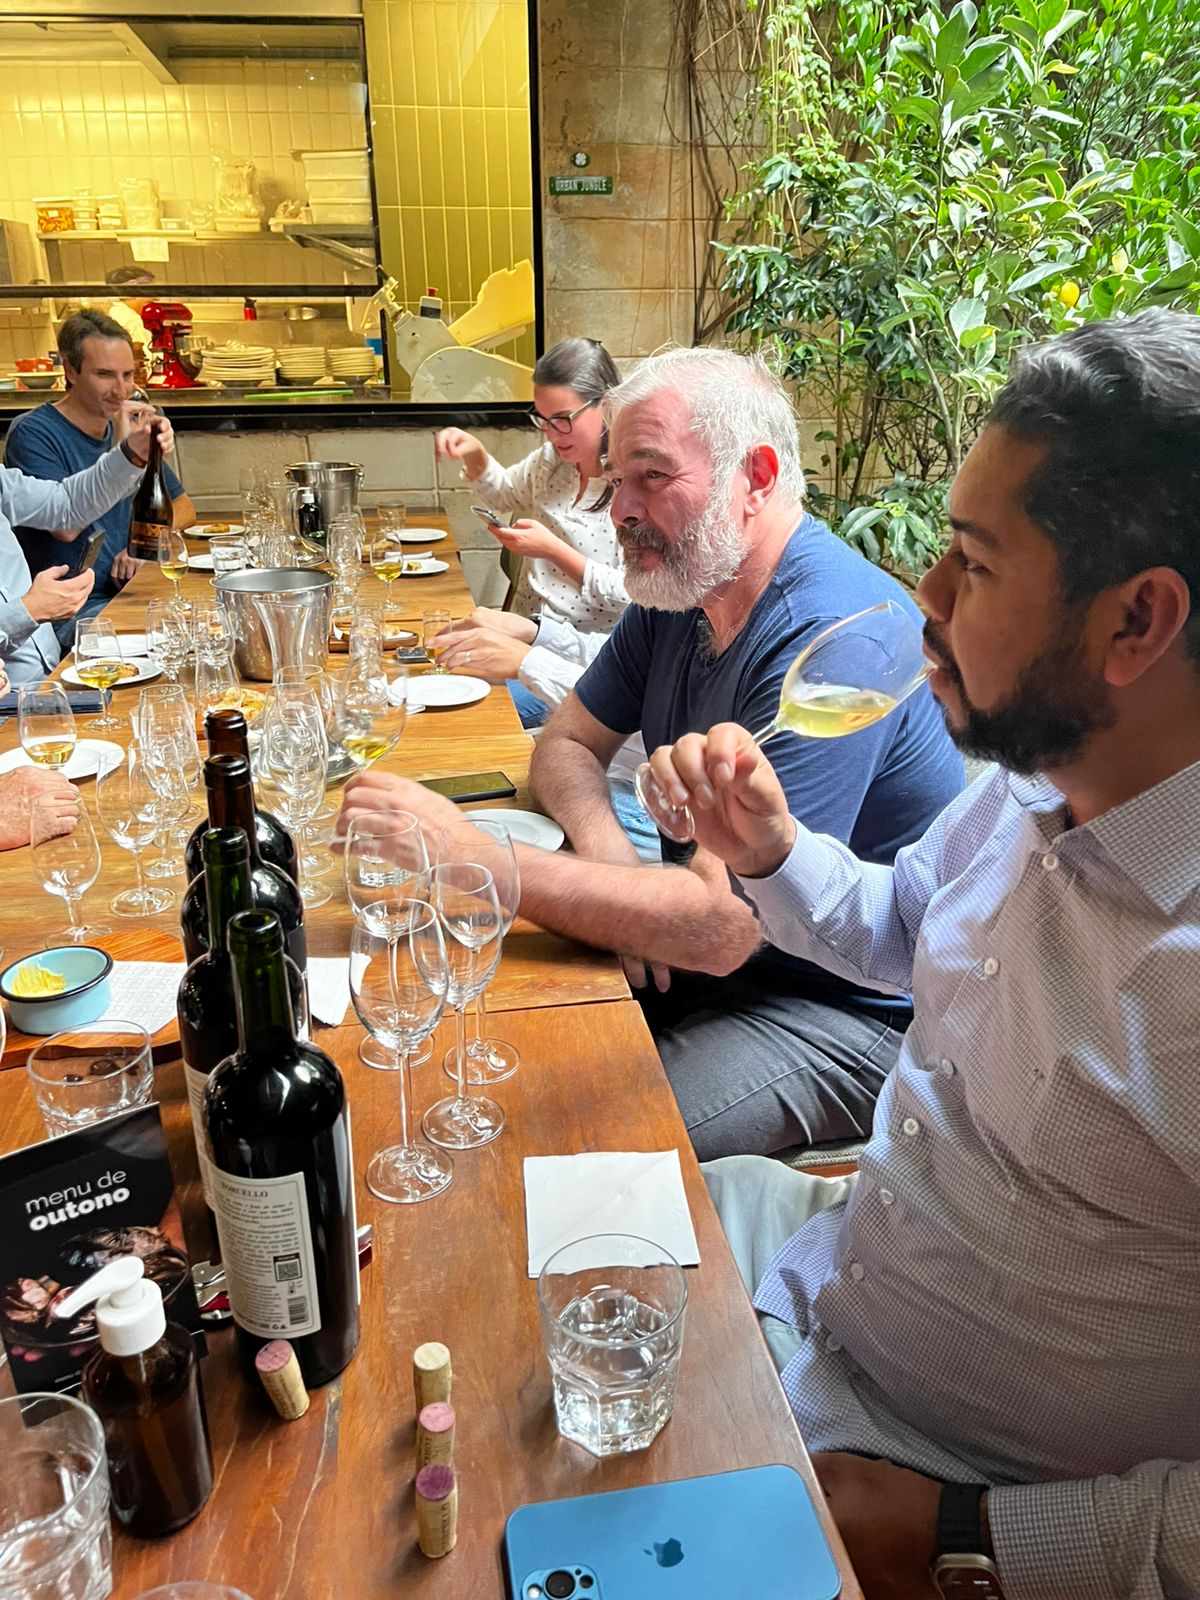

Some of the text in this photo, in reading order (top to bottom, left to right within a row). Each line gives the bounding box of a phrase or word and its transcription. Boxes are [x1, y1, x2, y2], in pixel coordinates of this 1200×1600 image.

[25, 1170, 127, 1214] menu de
[29, 1187, 131, 1231] outono
